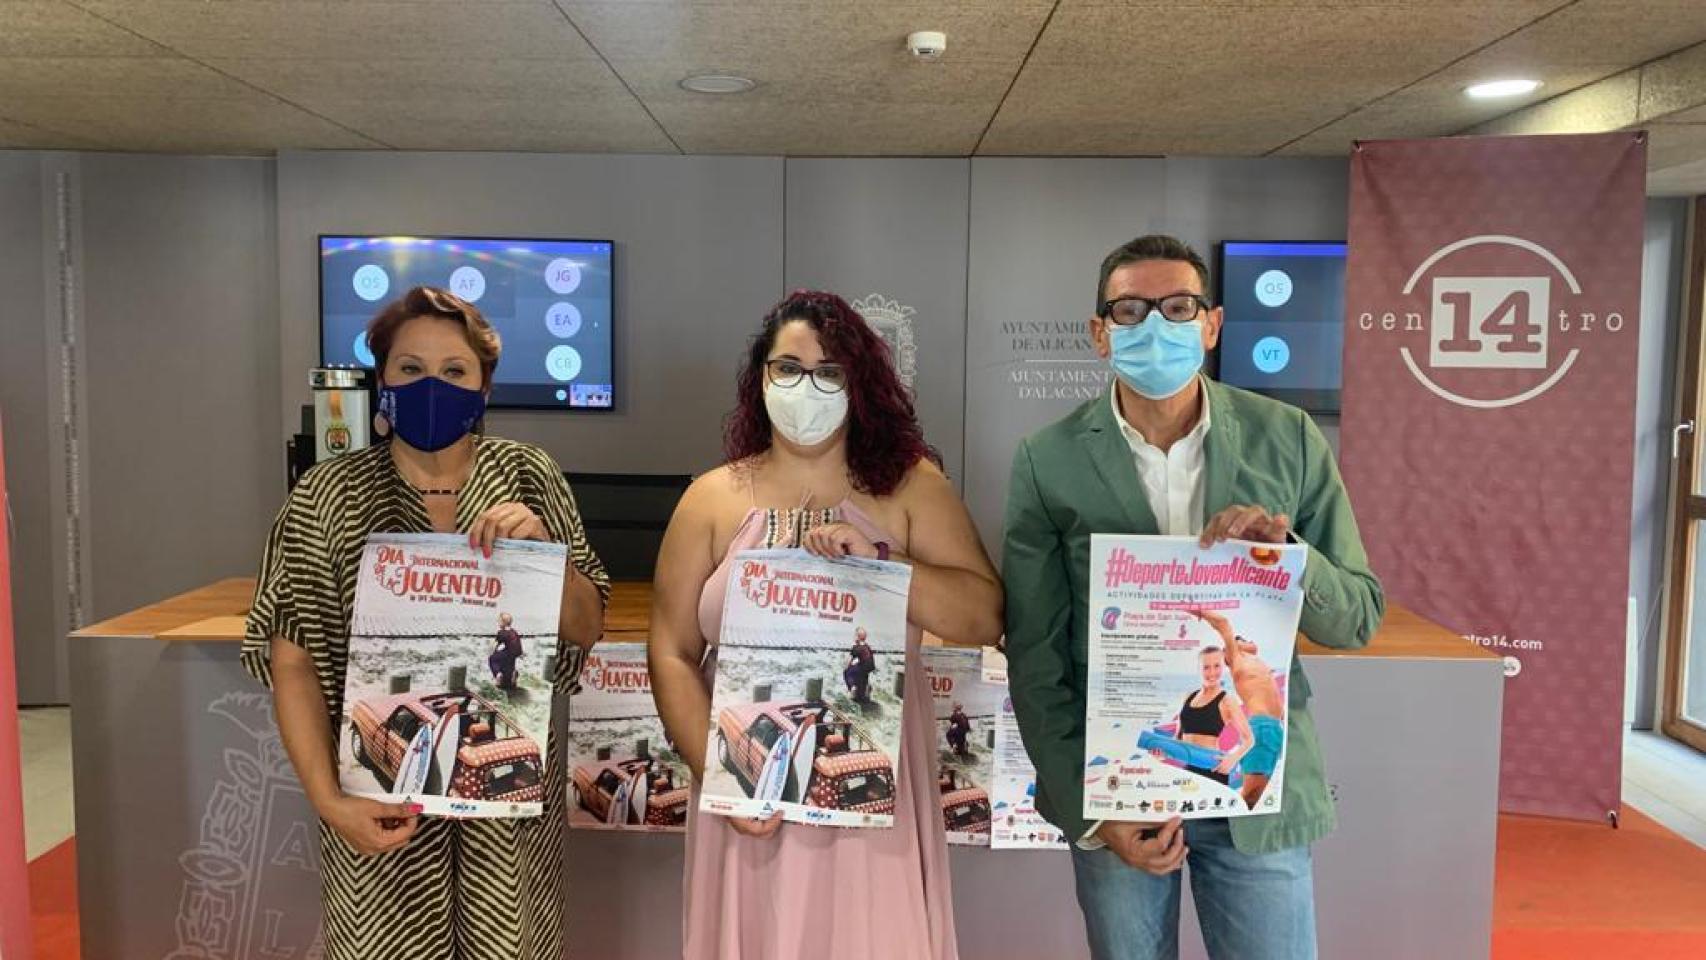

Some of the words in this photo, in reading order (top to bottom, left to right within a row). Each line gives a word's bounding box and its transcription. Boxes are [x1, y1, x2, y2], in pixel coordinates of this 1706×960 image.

[555, 269, 571, 282] JG
[459, 279, 475, 291] AF
[554, 314, 572, 326] EA
[1001, 319, 1092, 334] AYUNTAMIE
[1359, 312, 1424, 331] cen
[1438, 290, 1542, 352] 14
[1558, 308, 1624, 331] tro
[1011, 337, 1033, 351] DE
[1034, 337, 1093, 351] ALICAN
[1262, 348, 1280, 360] VT
[1009, 370, 1109, 383] AJUNTAMENT
[410, 554, 479, 570] INTERNACIONAL
[1105, 547, 1291, 591] #DeporteJovenAlicante
[392, 566, 502, 599] JUVENTUD
[772, 568, 834, 586] INTERNACIONAL
[758, 580, 857, 614] JUVENTUD
[1107, 592, 1166, 601] ACTIVIDADES
